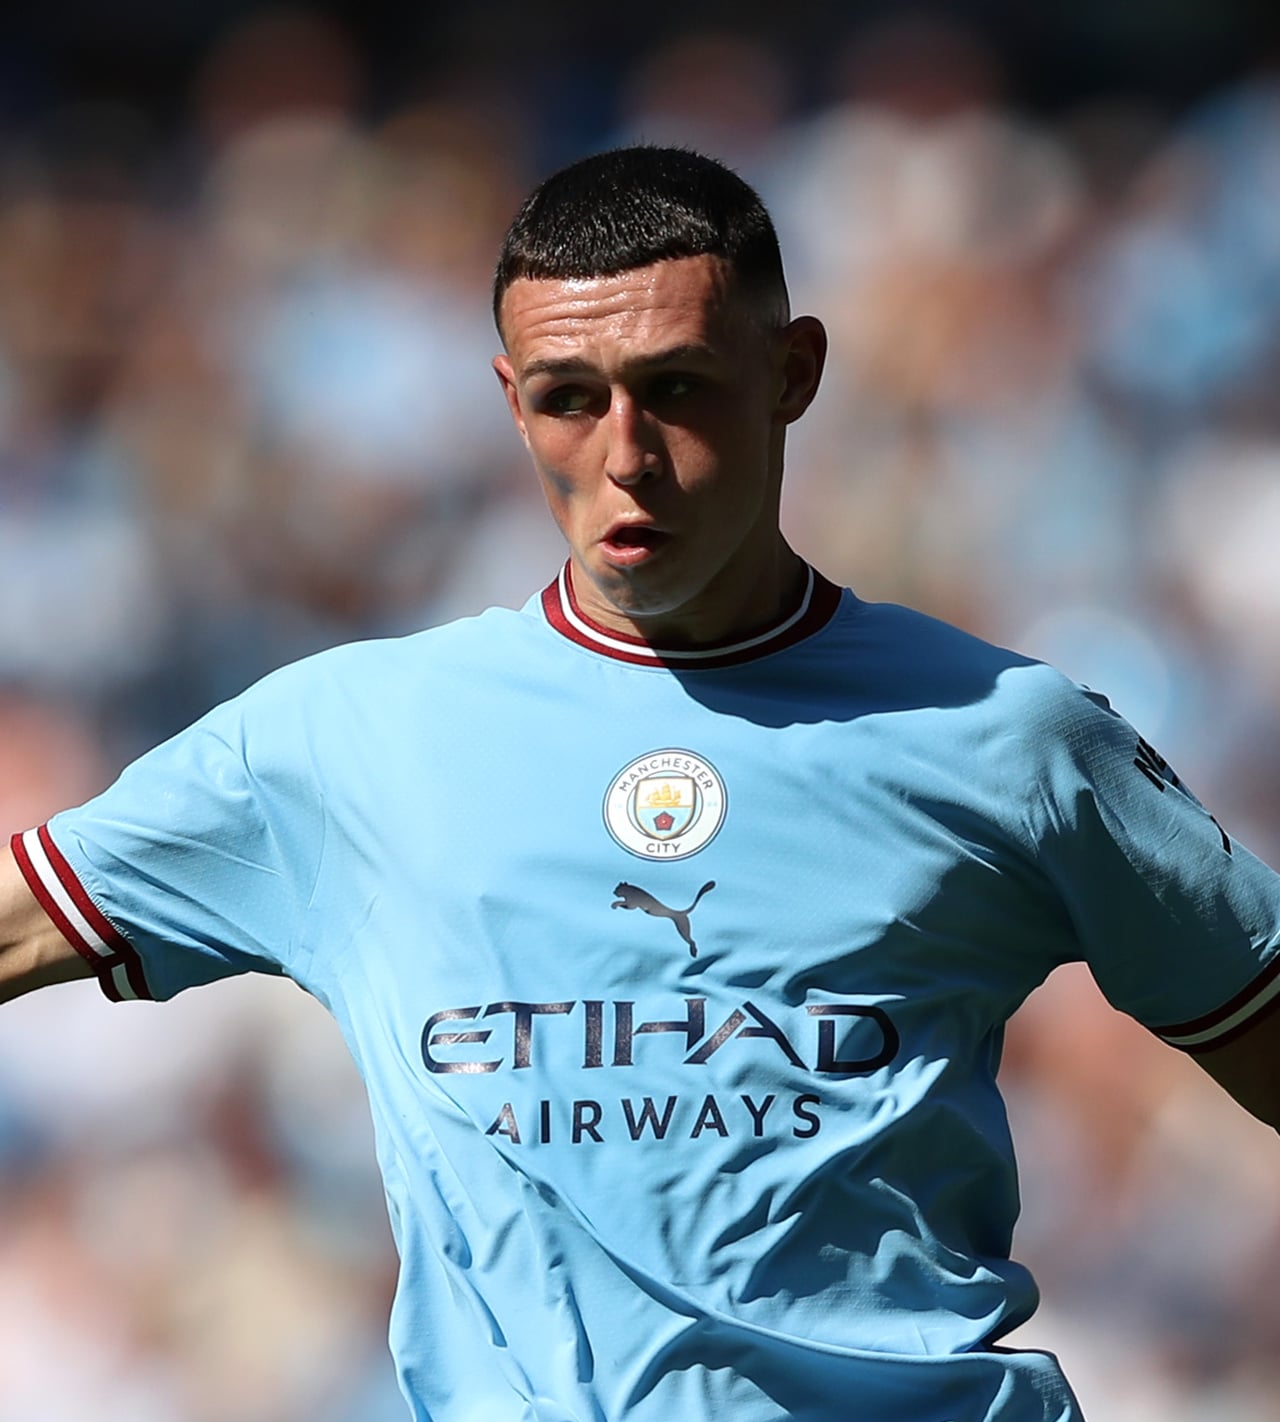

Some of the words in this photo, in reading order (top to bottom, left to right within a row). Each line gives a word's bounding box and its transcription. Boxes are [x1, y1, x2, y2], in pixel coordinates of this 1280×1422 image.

[618, 758, 714, 792] MANCHESTER
[646, 843, 682, 853] CITY
[421, 998, 901, 1074] ETIHAD
[485, 1094, 821, 1145] AIRWAYS
